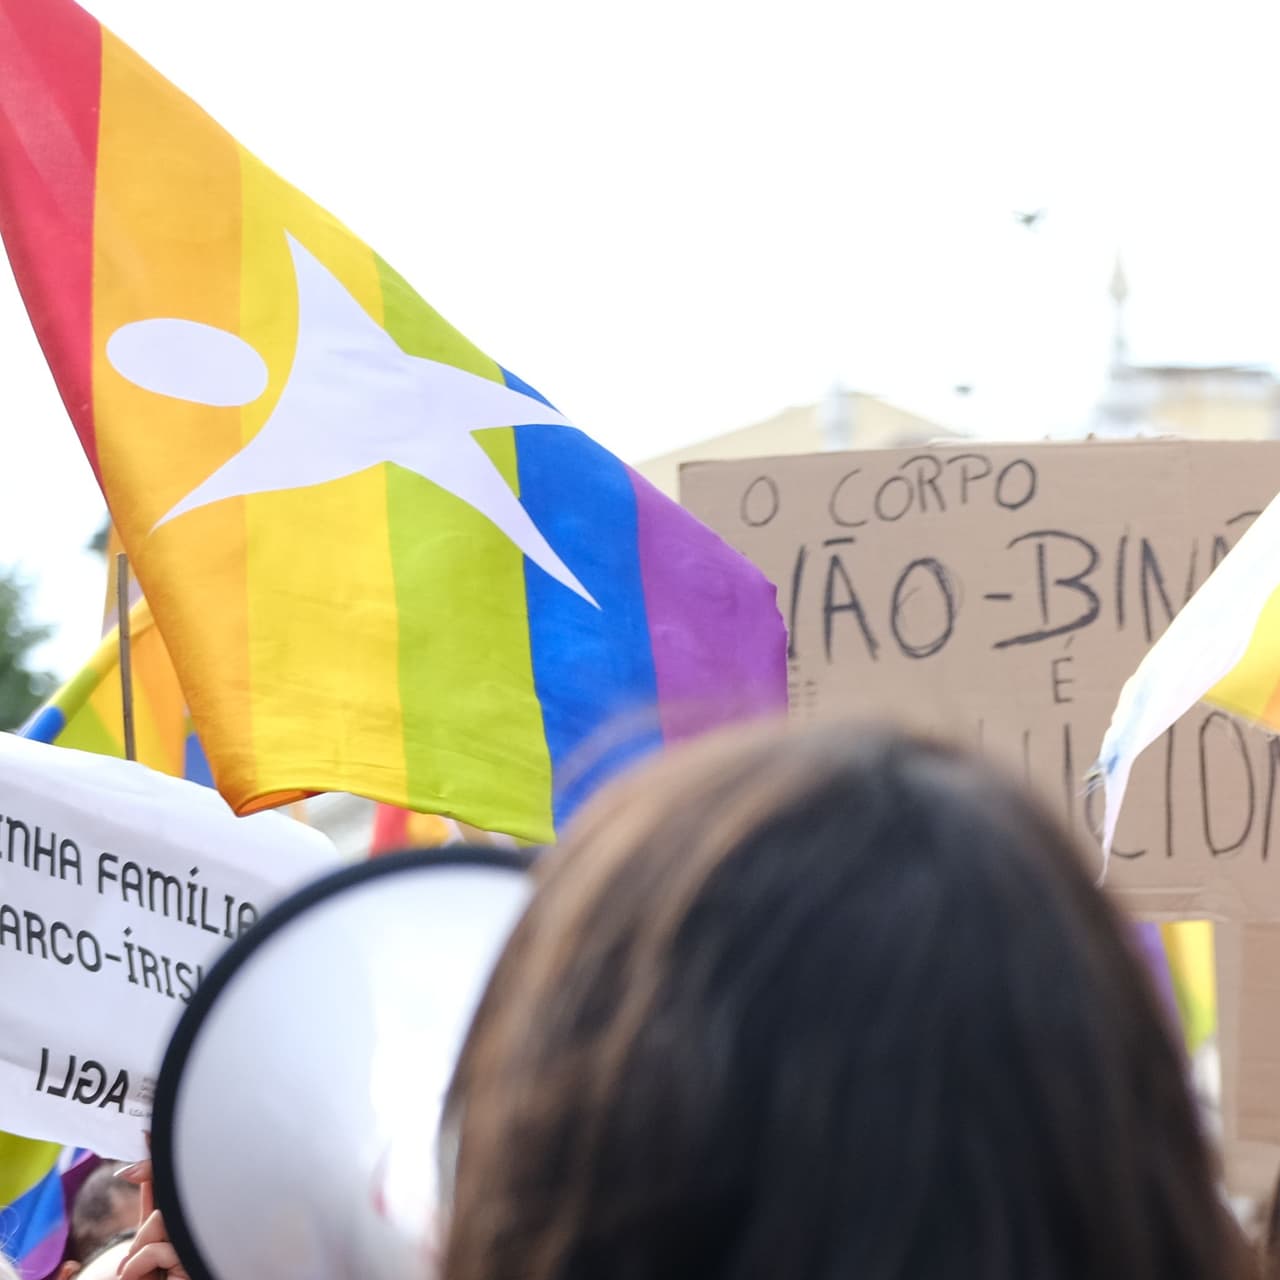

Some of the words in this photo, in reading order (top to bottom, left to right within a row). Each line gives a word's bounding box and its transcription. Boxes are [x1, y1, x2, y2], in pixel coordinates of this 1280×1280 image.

[741, 476, 780, 527] O
[829, 454, 1037, 527] CORPO
[787, 511, 1263, 665] ÃO-BIN
[0, 813, 83, 886] NHA
[0, 904, 204, 1004] ARCO-ÍRIS
